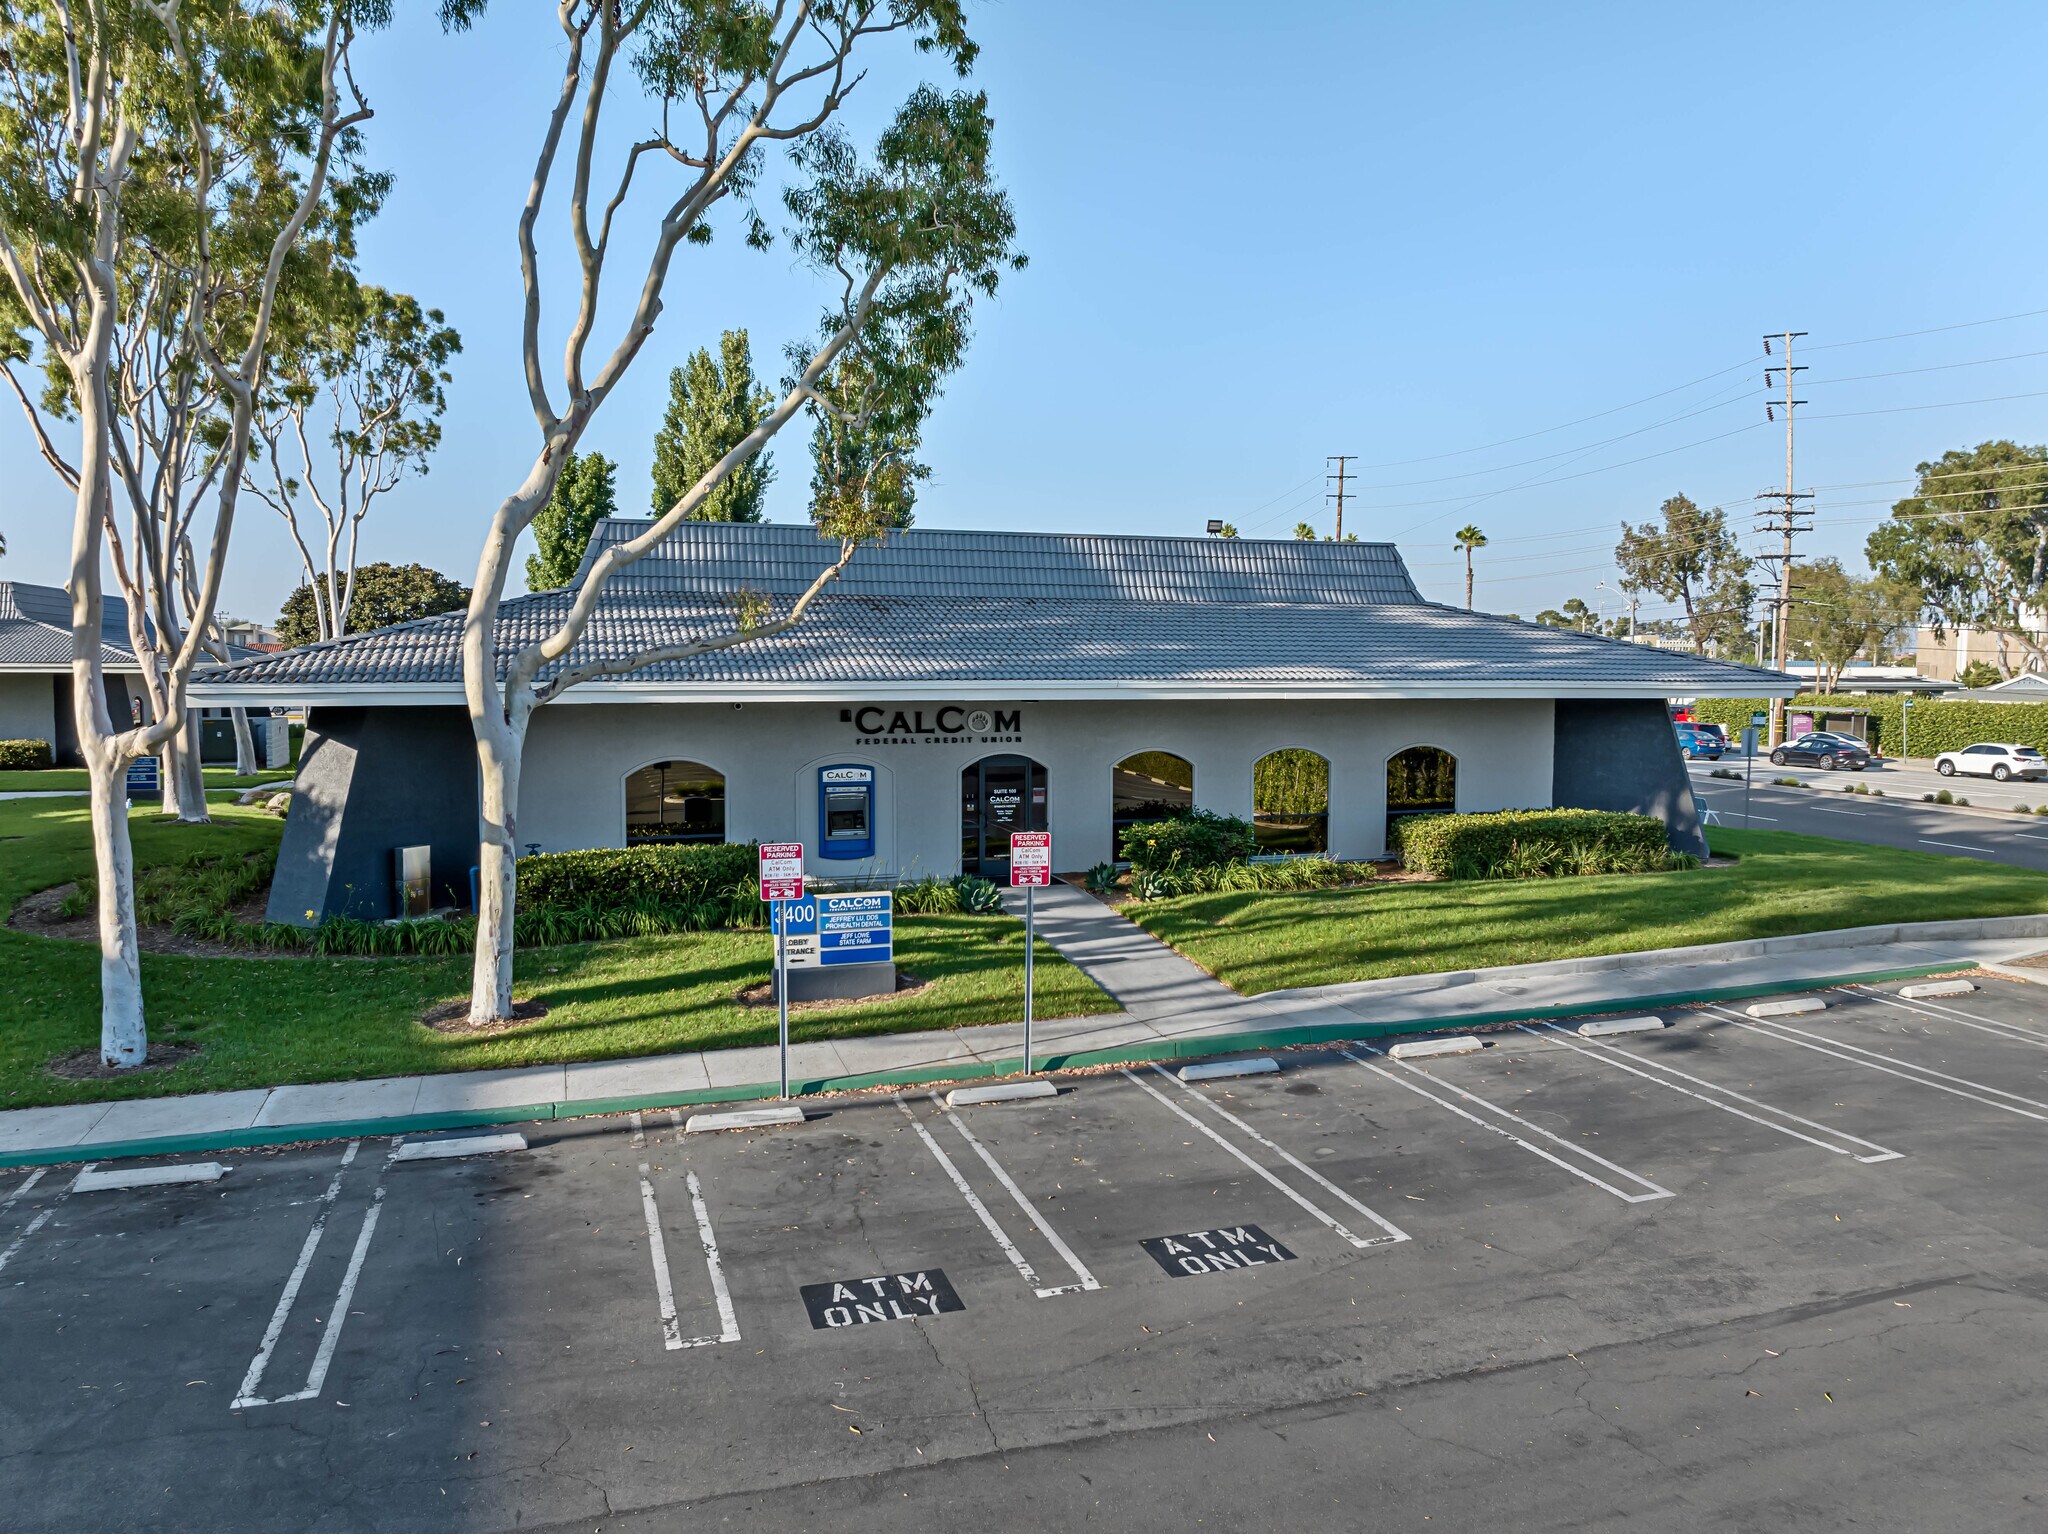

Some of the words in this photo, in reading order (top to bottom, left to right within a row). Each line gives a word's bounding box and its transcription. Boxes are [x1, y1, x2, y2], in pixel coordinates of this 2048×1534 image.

[856, 737, 917, 746] FEDERAL
[925, 736, 973, 745] CREDIT
[981, 736, 1022, 744] UNION
[763, 845, 799, 853] RESERVED
[829, 915, 856, 923] JEFFREY
[866, 913, 879, 921] DDS
[825, 922, 861, 930] PROHEALTH
[861, 920, 884, 928] DENTAL
[840, 932, 854, 940] JEFF
[785, 938, 809, 947] OBBY
[839, 938, 856, 946] STATE
[856, 937, 872, 945] FARM
[776, 947, 816, 957] TRANCE
[1161, 1226, 1257, 1255] ATM
[1177, 1243, 1286, 1275] ONLY
[832, 1272, 933, 1303] ATM
[823, 1293, 941, 1328] ONLY
